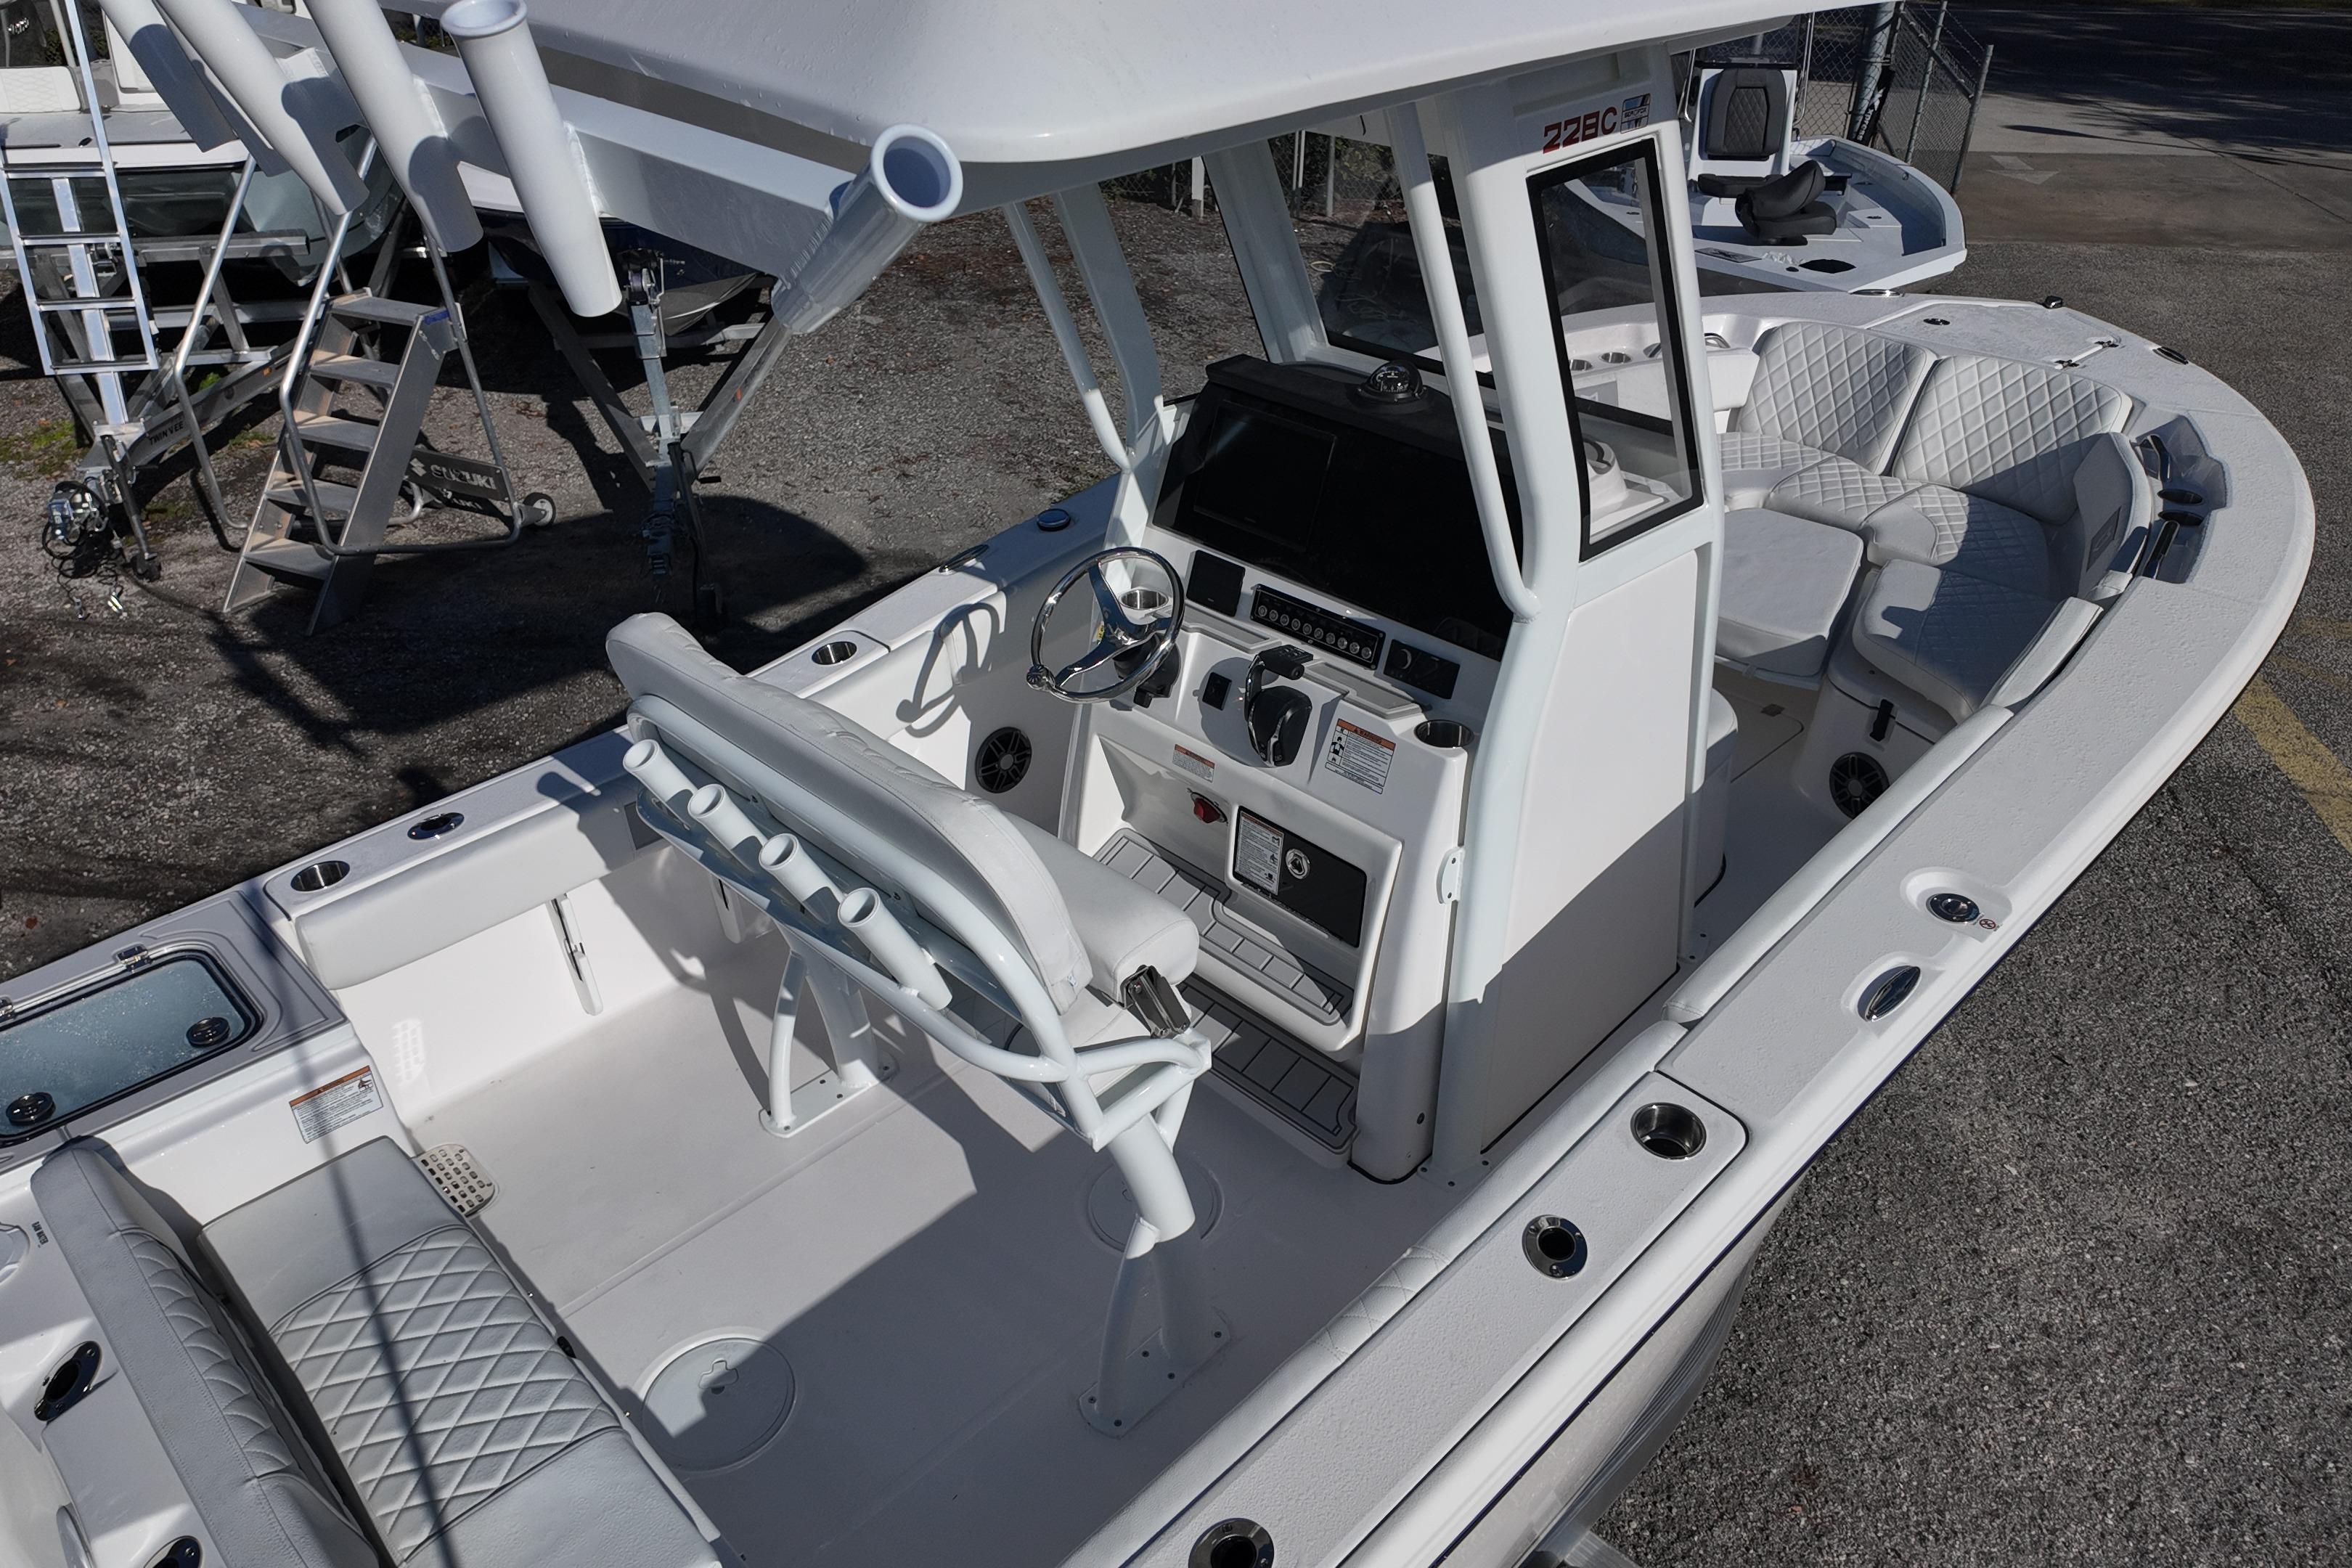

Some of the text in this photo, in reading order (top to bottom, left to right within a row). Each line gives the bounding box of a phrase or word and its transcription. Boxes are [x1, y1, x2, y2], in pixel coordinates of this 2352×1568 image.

[150, 421, 184, 445] TWIN VEE
[430, 465, 497, 490] SUZUKI
